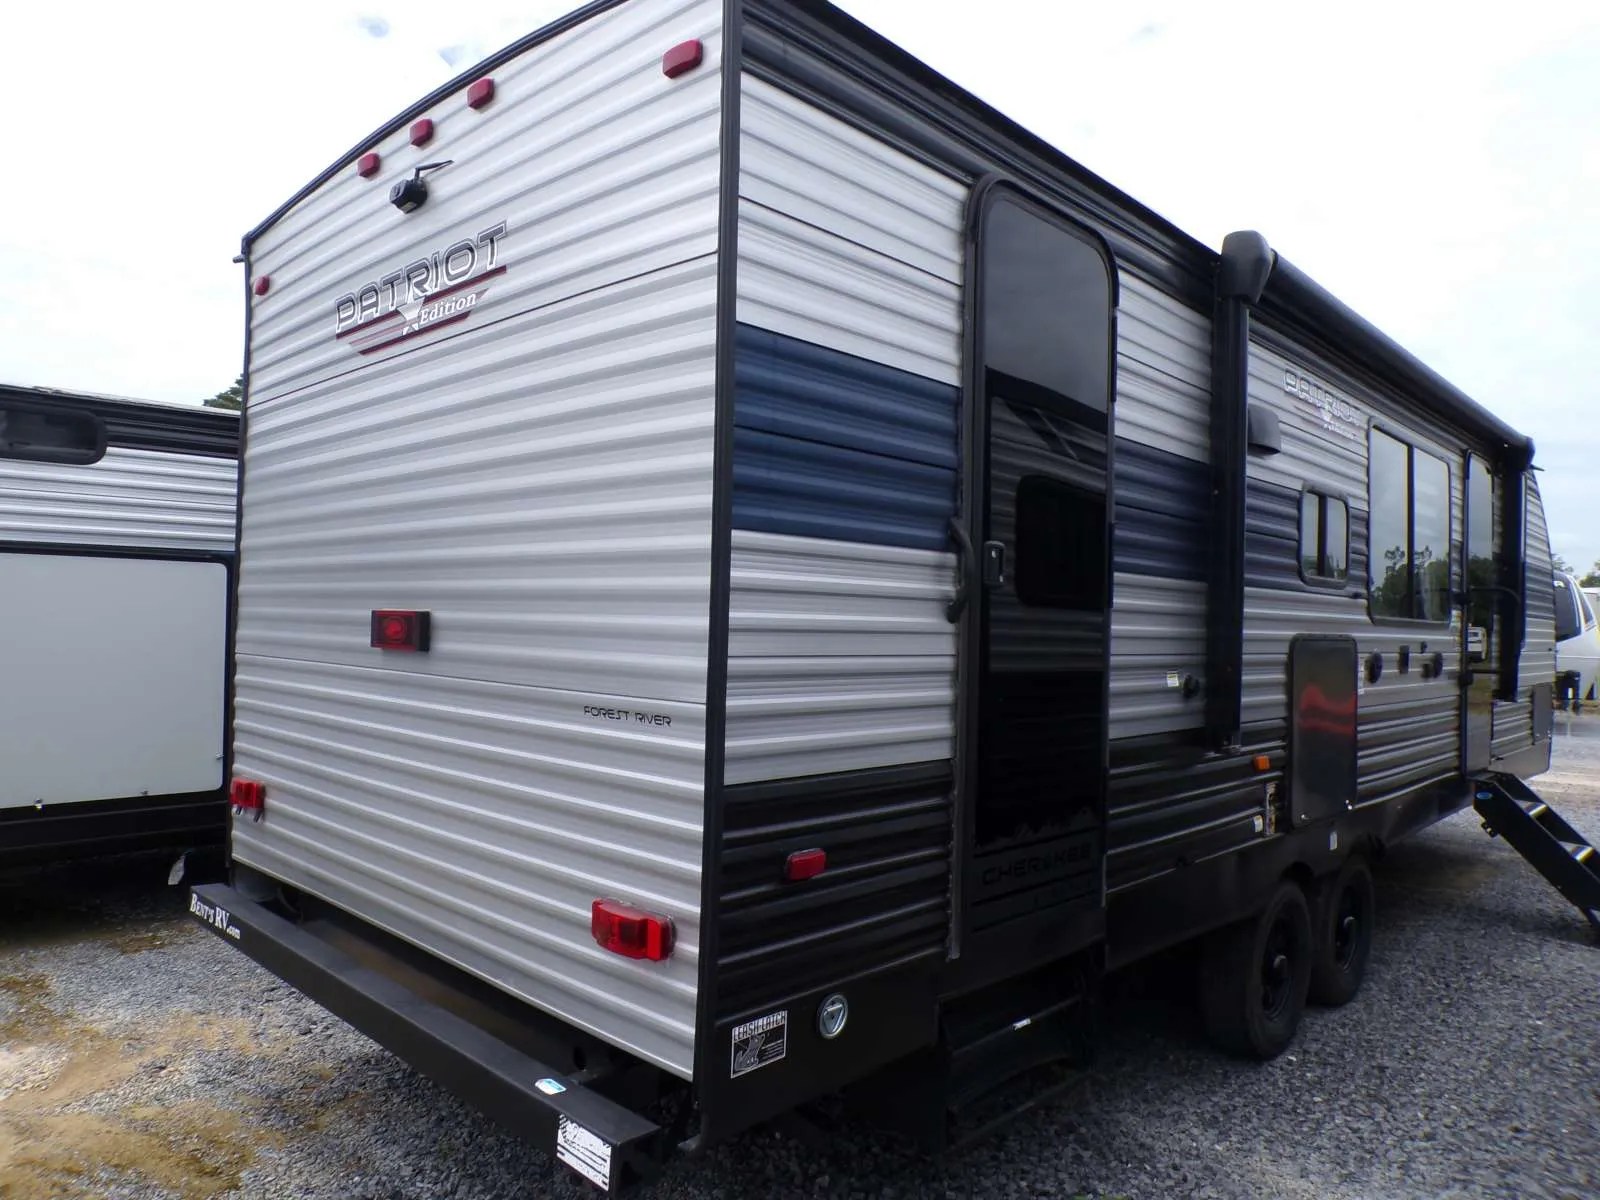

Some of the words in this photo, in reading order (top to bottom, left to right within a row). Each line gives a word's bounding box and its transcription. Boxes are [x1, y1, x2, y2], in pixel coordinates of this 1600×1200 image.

[333, 220, 508, 333] PATRIOT
[420, 293, 476, 325] Edition
[583, 705, 630, 720] FOREST
[634, 712, 672, 727] RIVER
